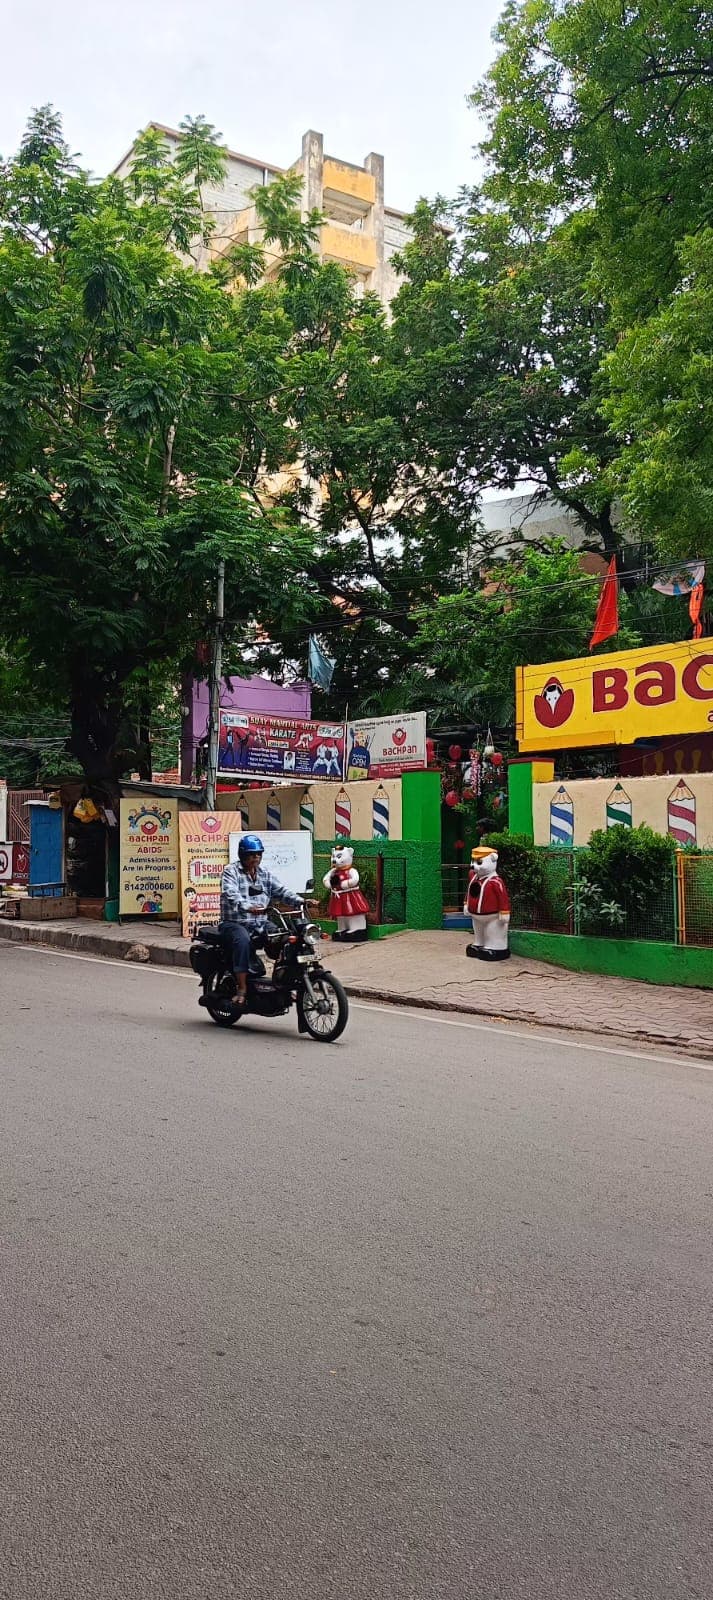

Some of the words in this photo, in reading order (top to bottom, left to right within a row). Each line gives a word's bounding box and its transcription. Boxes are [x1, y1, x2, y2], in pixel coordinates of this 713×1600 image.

[270, 719, 298, 729] MARTIAL
[269, 727, 297, 739] KARATE
[136, 846, 162, 854] ABIDS
[145, 864, 176, 873] Progress
